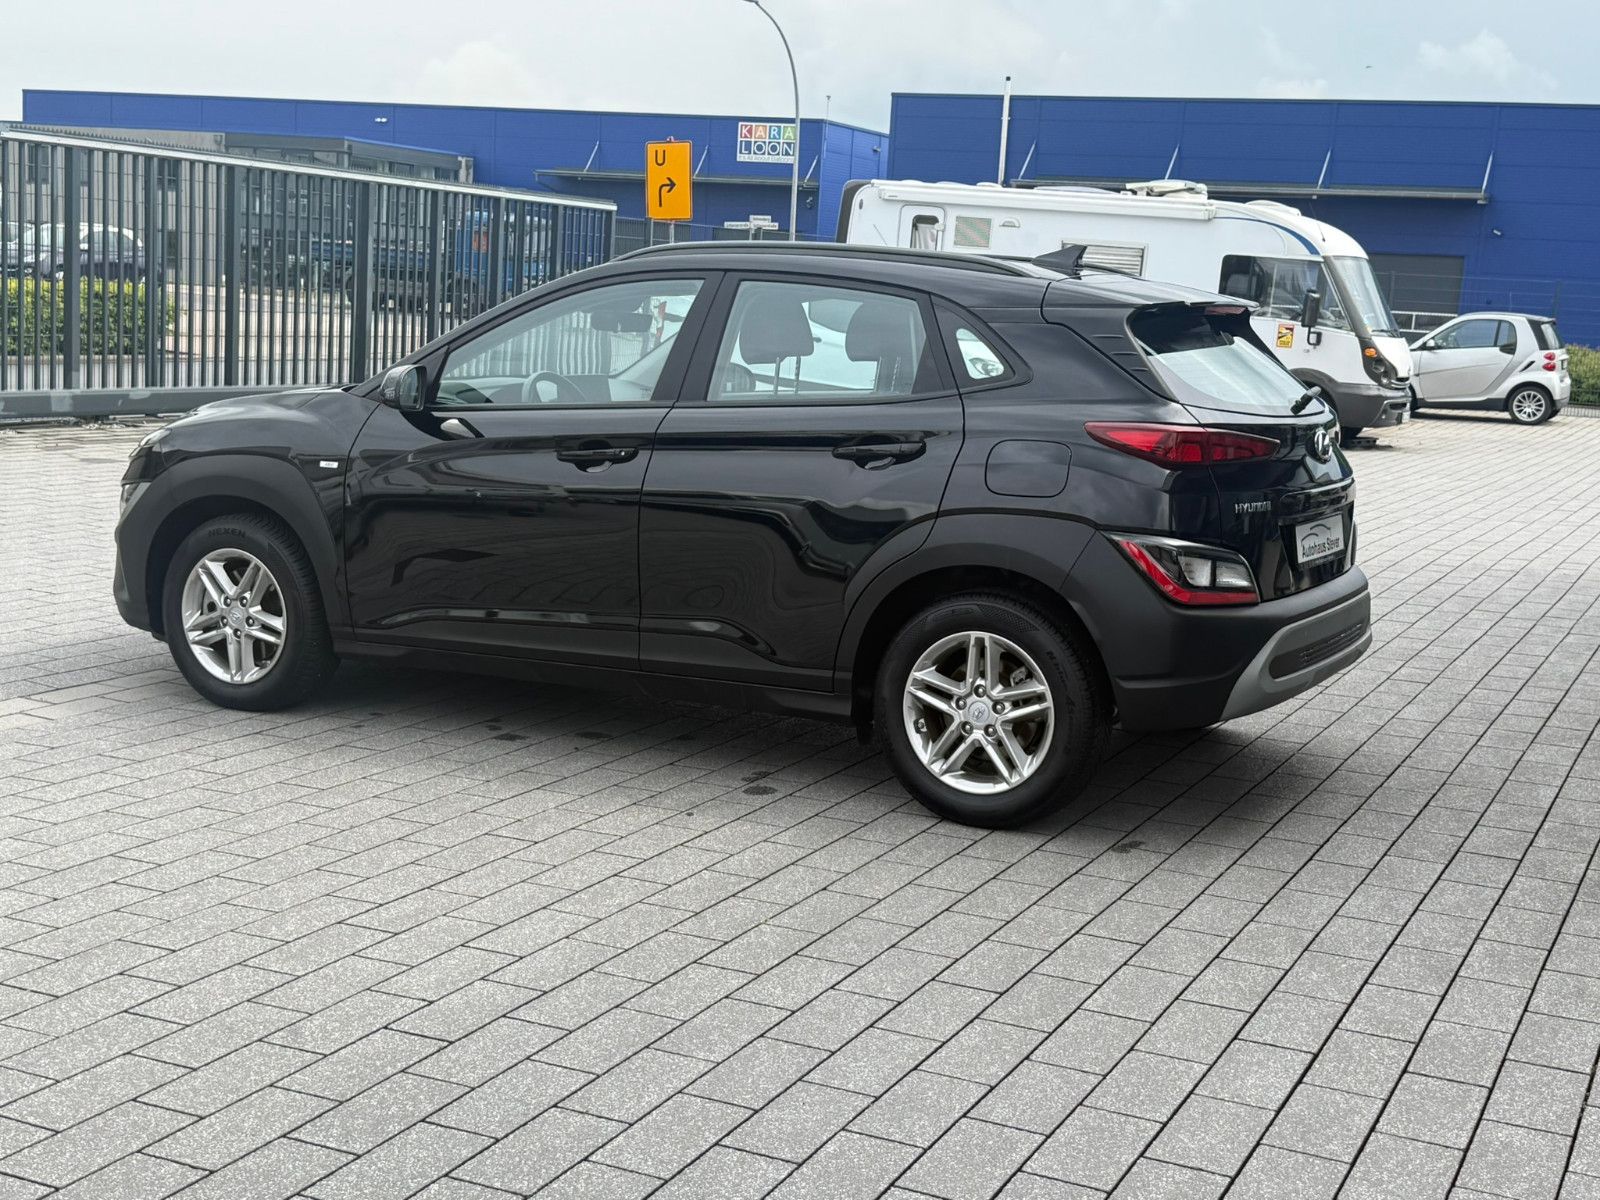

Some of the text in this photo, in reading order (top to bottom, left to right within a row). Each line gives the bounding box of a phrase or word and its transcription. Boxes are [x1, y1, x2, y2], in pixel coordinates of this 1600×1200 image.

[741, 125, 795, 140] KARA
[741, 140, 794, 156] LOON
[654, 149, 666, 167] U
[1235, 501, 1271, 513] HYUNDAI
[208, 527, 246, 539] NEXEN
[1302, 540, 1327, 558] Autohaus
